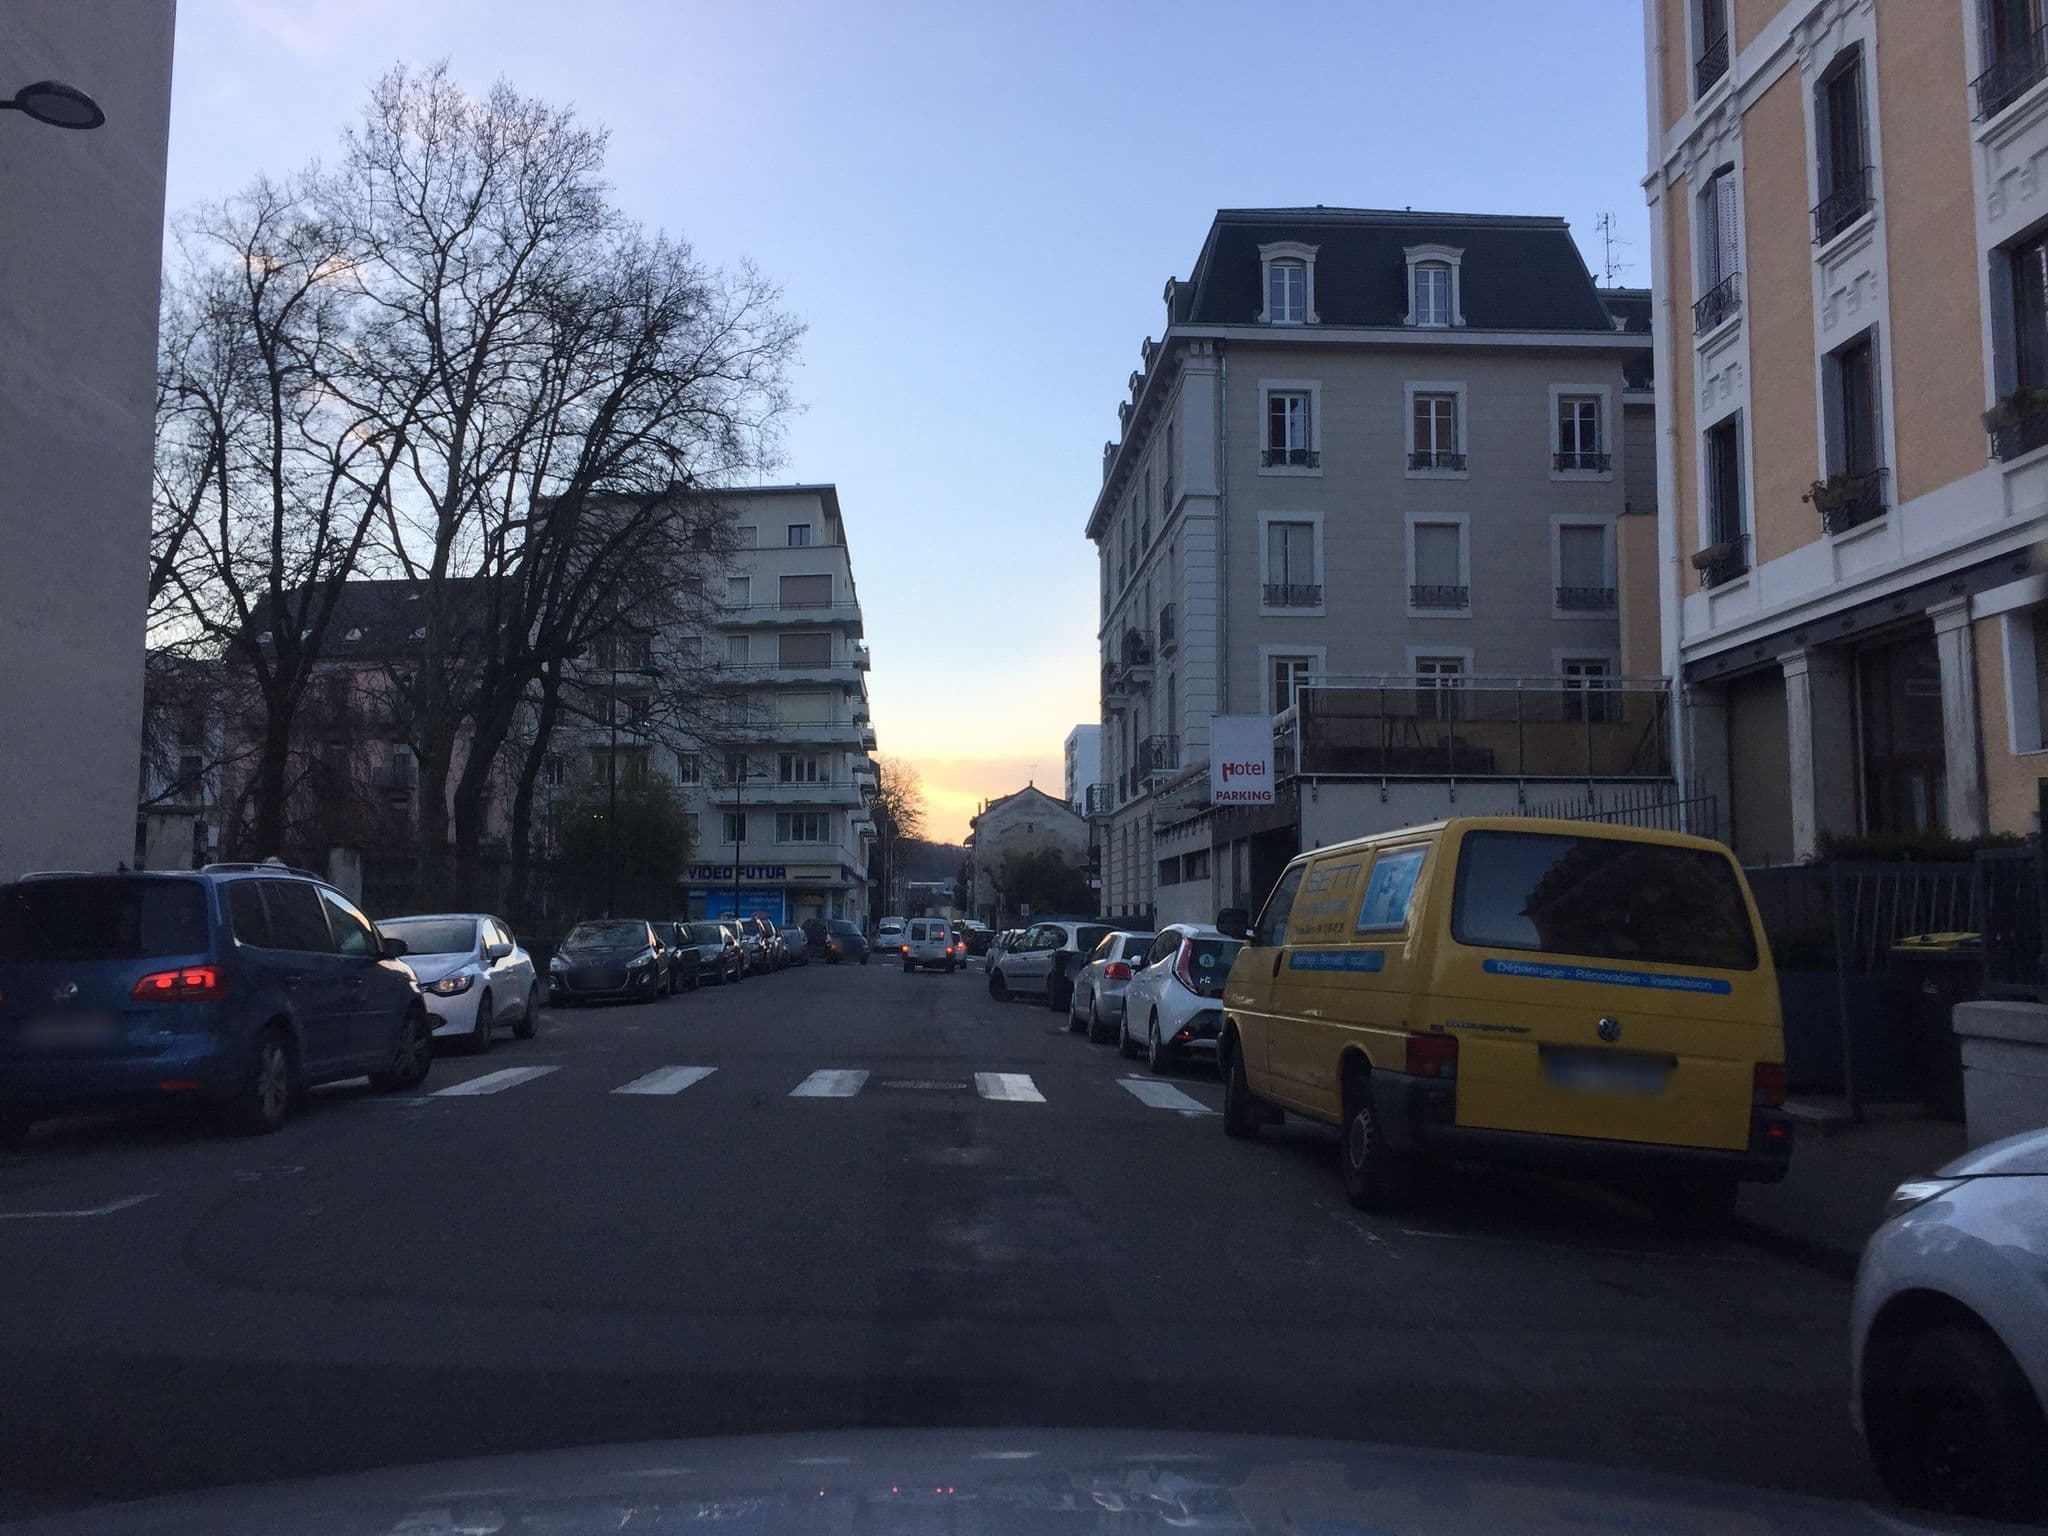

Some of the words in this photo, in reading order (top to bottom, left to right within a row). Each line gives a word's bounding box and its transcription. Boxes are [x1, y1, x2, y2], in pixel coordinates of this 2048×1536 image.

[1222, 760, 1266, 783] Hotel
[1215, 790, 1272, 801] PARKING
[689, 864, 733, 879] VIDEO
[737, 864, 786, 879] FUTUR
